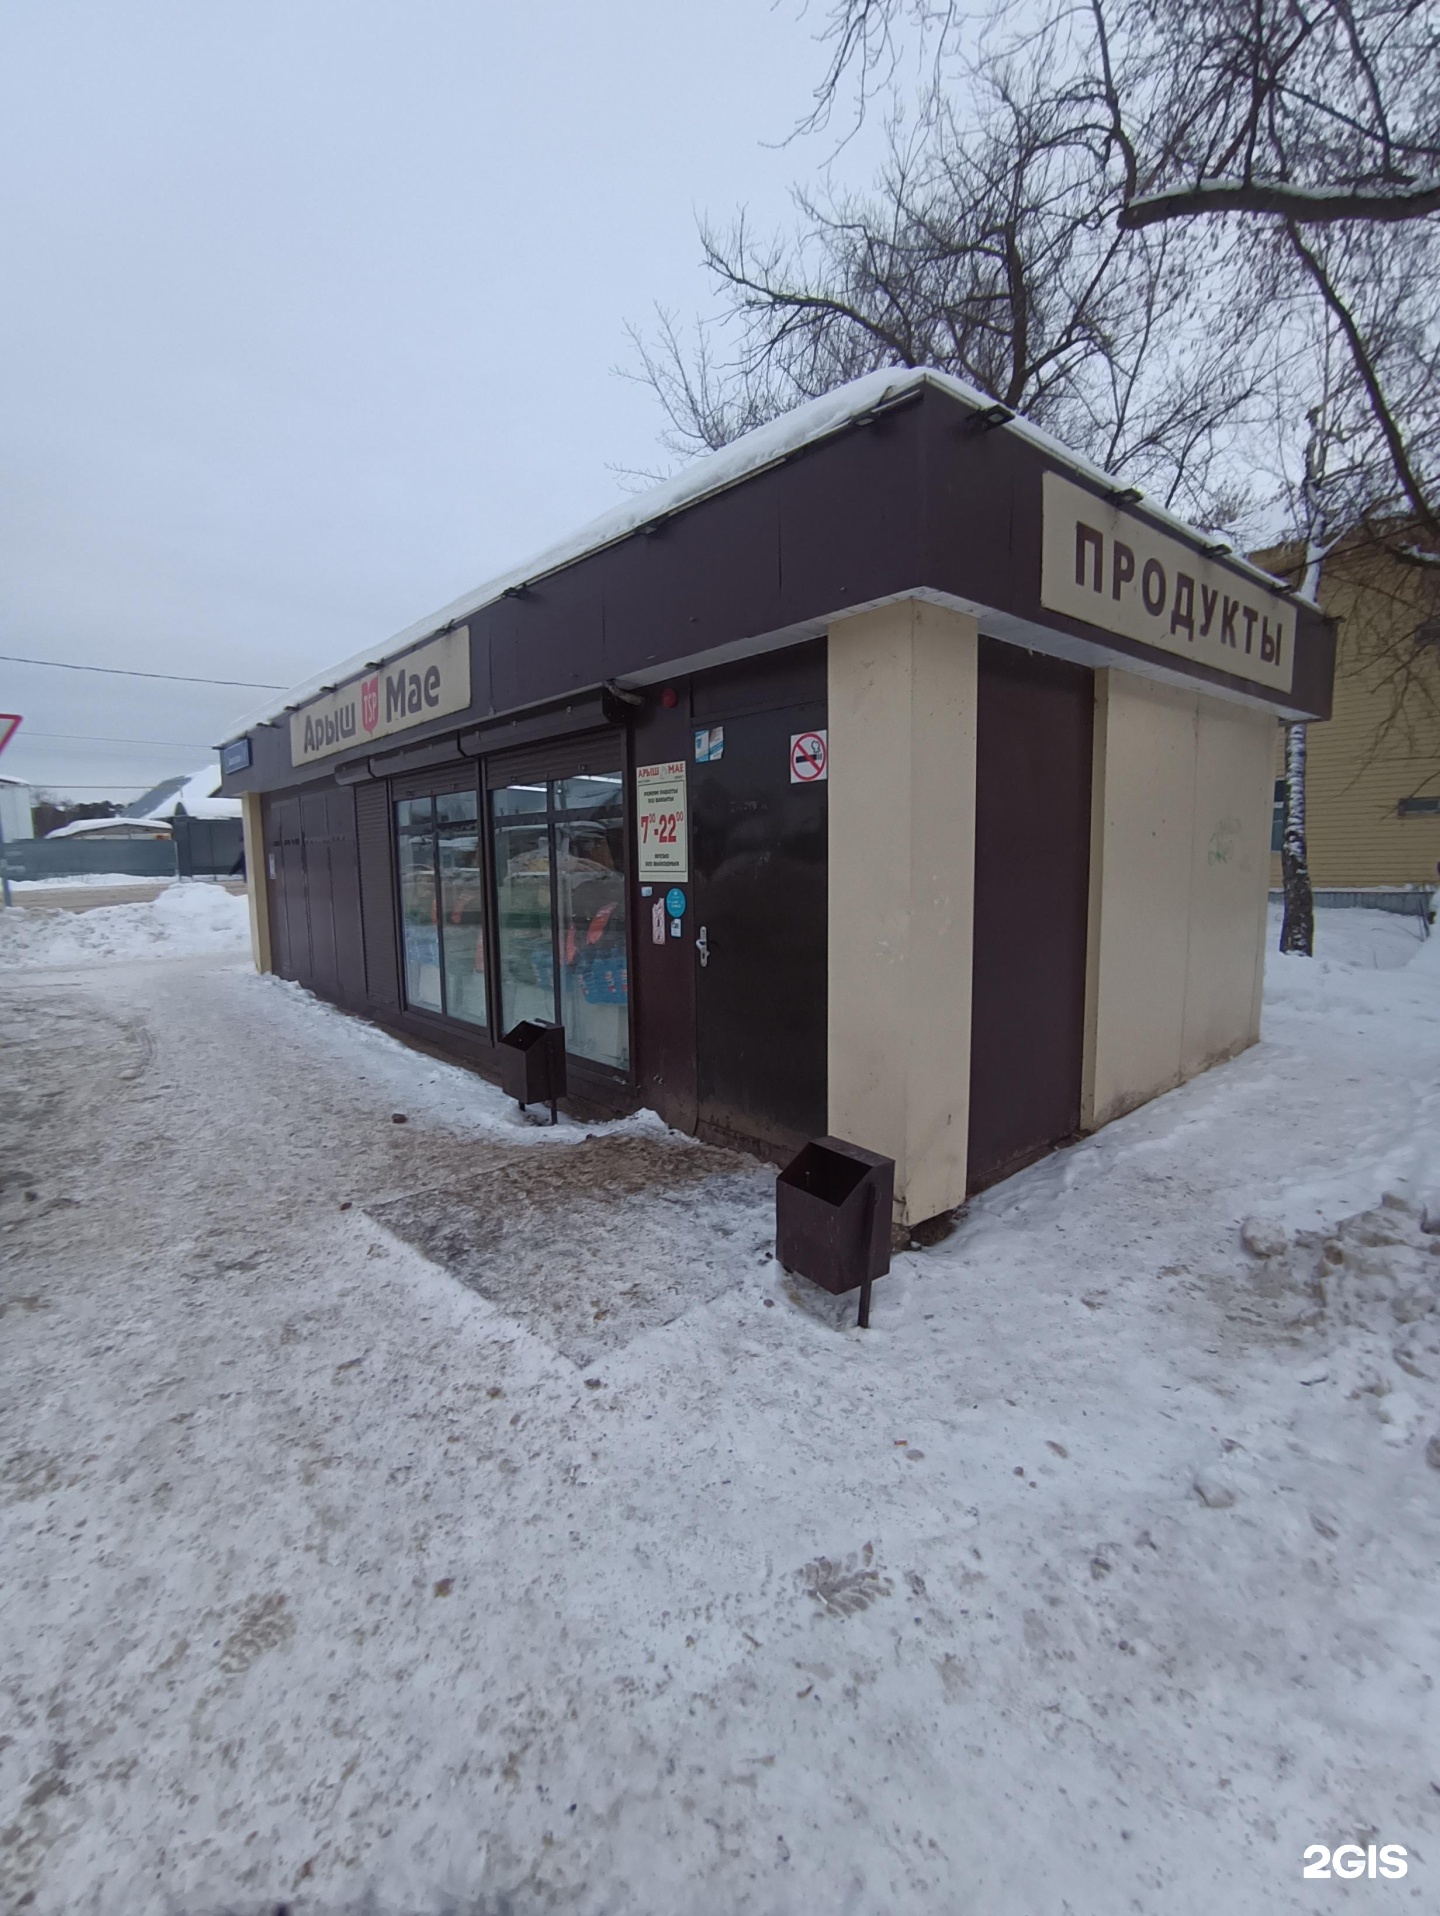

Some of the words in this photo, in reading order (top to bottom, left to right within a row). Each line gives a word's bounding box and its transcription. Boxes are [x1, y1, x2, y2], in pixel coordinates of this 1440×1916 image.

[1074, 520, 1284, 667] ПРОДУКТЫ
[303, 702, 356, 754] Арыш
[386, 665, 441, 723] Мае
[638, 766, 660, 778] АРЫШ
[668, 763, 684, 774] МАЕ
